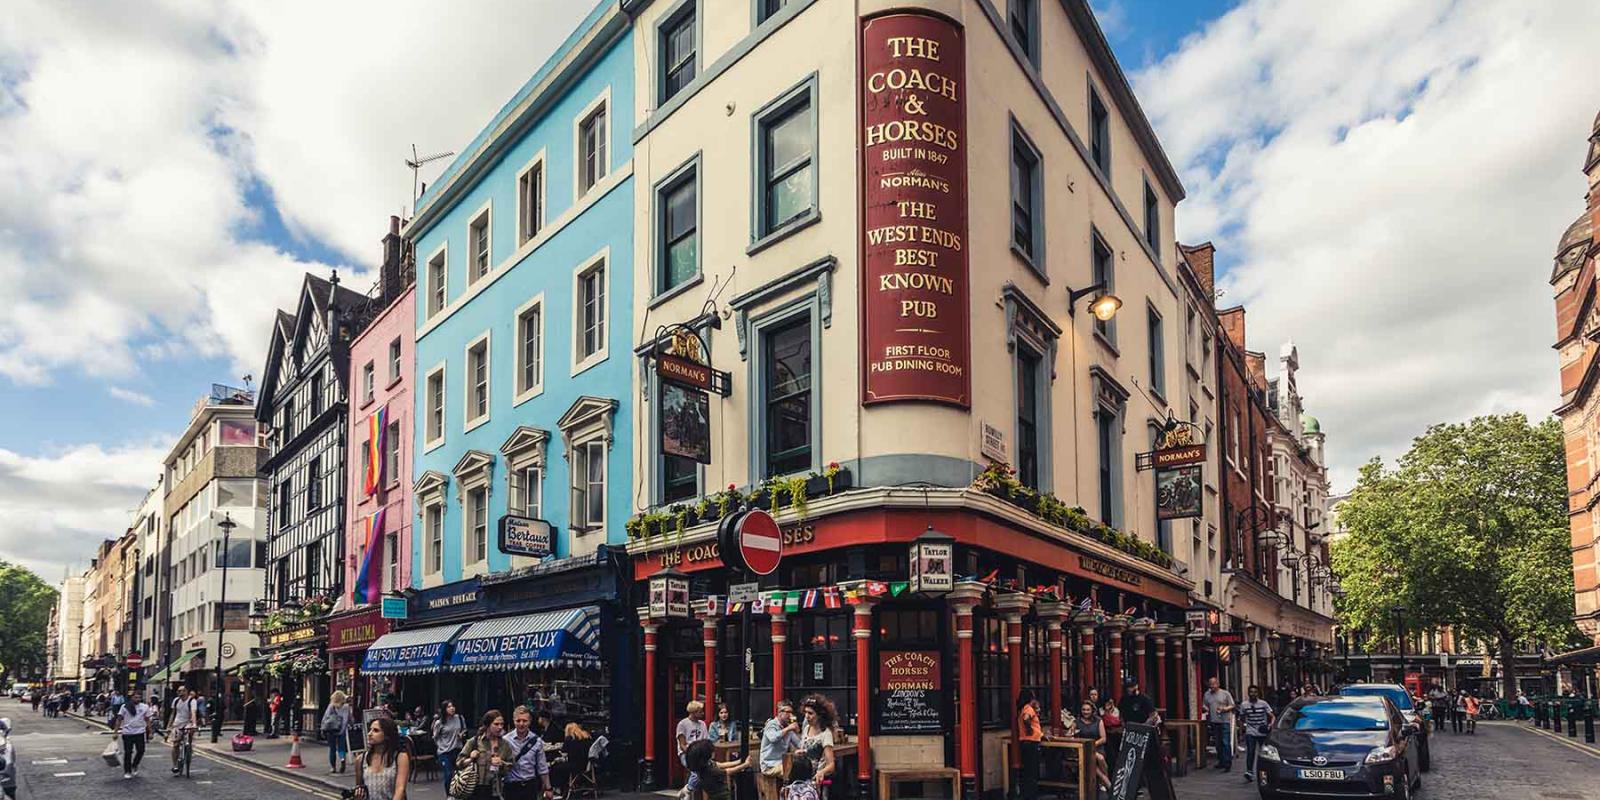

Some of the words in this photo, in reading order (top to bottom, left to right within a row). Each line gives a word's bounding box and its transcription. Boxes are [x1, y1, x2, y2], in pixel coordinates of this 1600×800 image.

[888, 36, 940, 61] THE
[868, 69, 957, 102] COACH
[905, 94, 927, 115] &
[866, 120, 958, 150] HORSES
[883, 148, 912, 161] BUILT
[914, 148, 926, 159] IN
[927, 150, 948, 165] 1847
[881, 177, 949, 193] NORMAN'S
[897, 201, 937, 220] THE
[868, 226, 918, 245] WEST
[895, 249, 938, 267] BEST
[879, 273, 953, 295] KNOWN
[901, 300, 938, 318] PUB
[886, 346, 915, 357] FIRST
[918, 346, 950, 359] FLOOR
[663, 361, 705, 382] NORMAN'S
[871, 360, 893, 372] PUB
[895, 360, 934, 371] DINING
[936, 361, 962, 377] ROOM
[1160, 450, 1200, 462] NORMAN'S
[507, 527, 549, 543] Bertaux
[659, 551, 681, 567] THE
[687, 544, 720, 562] COAC
[924, 547, 947, 555] TAYLOR
[455, 638, 498, 654] MAISON
[500, 631, 559, 651] BERTAUX
[367, 649, 398, 661] MAISON
[399, 643, 441, 660] BERTAUX
[885, 654, 903, 668] THE
[904, 652, 936, 667] COACH
[891, 667, 929, 675] HORSES
